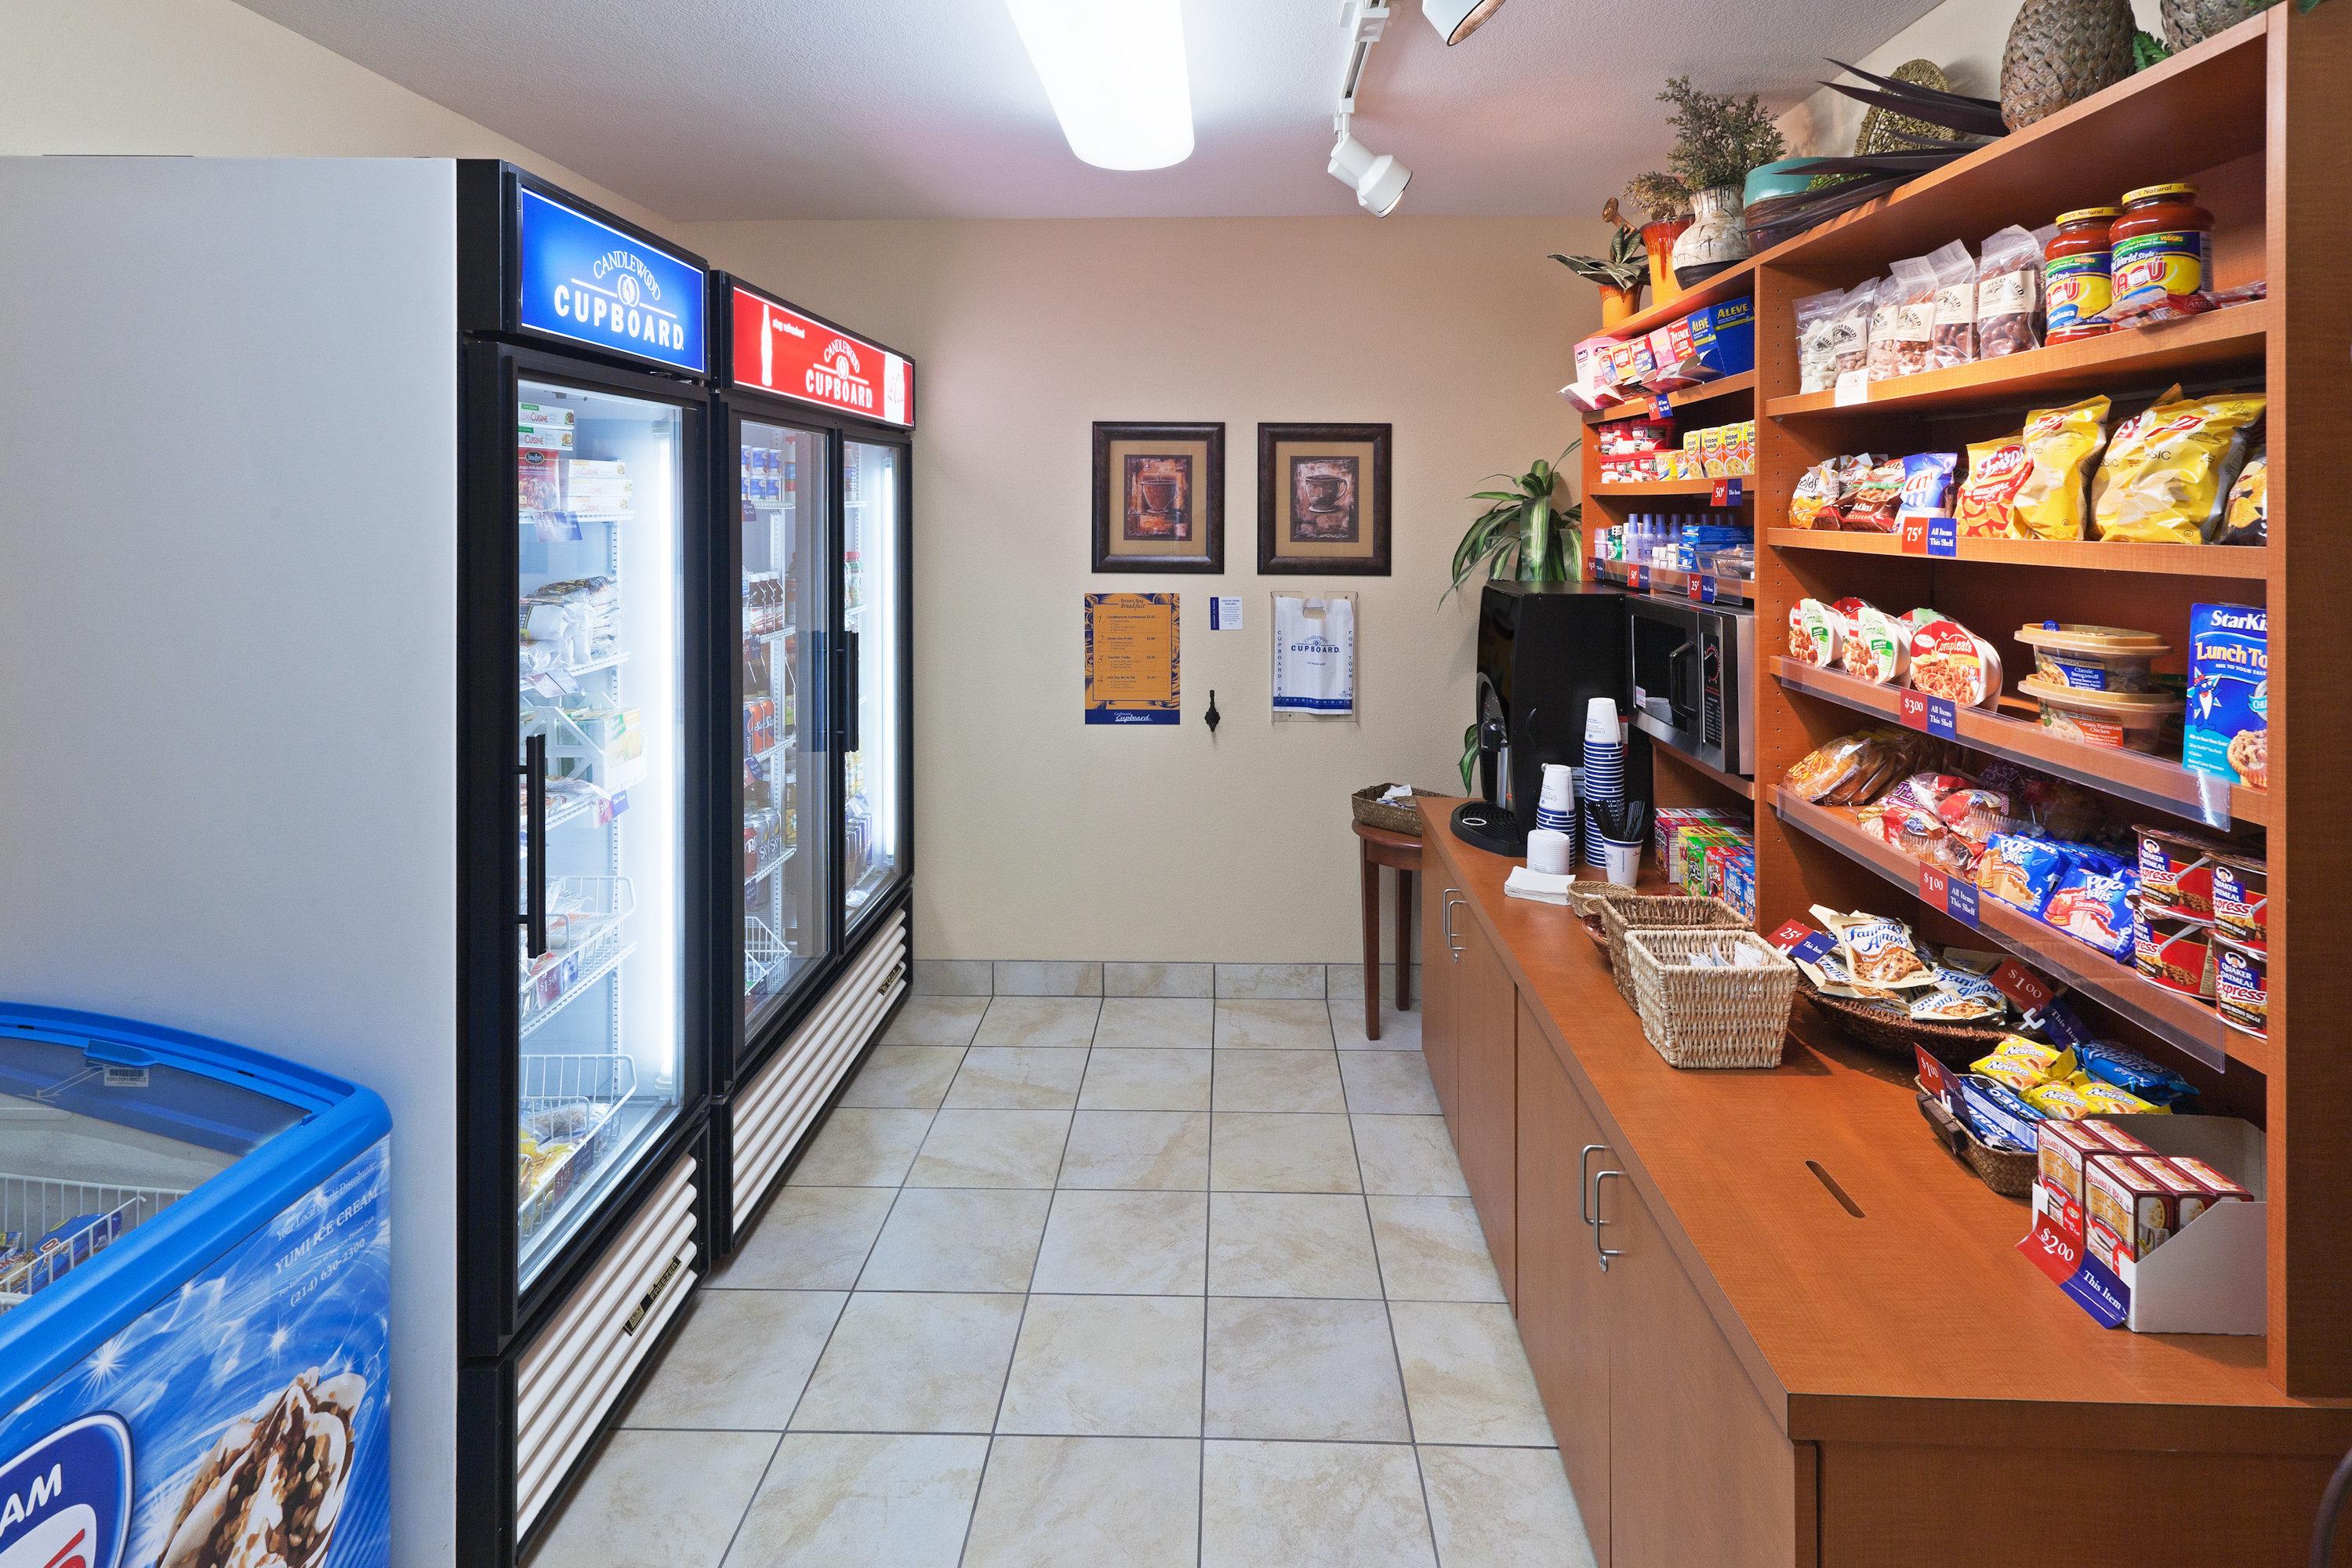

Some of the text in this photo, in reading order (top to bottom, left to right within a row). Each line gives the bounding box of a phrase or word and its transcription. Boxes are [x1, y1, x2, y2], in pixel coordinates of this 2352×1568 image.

[2143, 184, 2172, 194] Natural
[593, 251, 661, 301] CANDLEWOOD
[1716, 303, 1748, 320] ALEVE
[1692, 317, 1710, 333] ALEVE
[824, 339, 860, 373] CANDLEWOOD
[1852, 503, 1875, 512] Mini
[1906, 525, 1923, 542] 75¢
[1939, 528, 1953, 537] Items
[1929, 537, 1954, 547] This Shelf
[1120, 603, 1145, 612] Breakfast
[2211, 609, 2267, 632] StarKi
[1934, 636, 1973, 655] Compleats
[2195, 641, 2247, 666] Lunch
[1930, 705, 1951, 718] All Items
[1929, 714, 1953, 729] This Shelf
[2141, 849, 2164, 863] QUAKER
[1923, 872, 1944, 891] $100
[2214, 878, 2238, 892] QUAKER
[1951, 887, 1974, 905] All Items
[2035, 887, 2043, 898] 2
[1950, 896, 1976, 916] This Shelf
[2072, 901, 2110, 915] Strawberry
[1780, 927, 1803, 940] 25¢
[1845, 924, 1904, 942] Famous
[1861, 932, 1904, 952] Amos
[1803, 940, 1814, 949] This
[2220, 971, 2256, 989] OATMEAL
[2221, 962, 2252, 980] QUAKER
[2007, 968, 2042, 999] $100
[2216, 975, 2267, 1001] Express
[2051, 1008, 2066, 1028] This
[2004, 1046, 2045, 1058] Newtons
[1921, 1056, 1939, 1078] $100
[1985, 1060, 2030, 1076] Newtons
[2041, 1089, 2087, 1107] Newtons
[2087, 1087, 2137, 1105] Newtons
[2038, 1134, 2063, 1155] BUMBLE
[2063, 1148, 2074, 1166] BEE
[2086, 1171, 2125, 1207] BUMBLE BEE
[274, 1185, 379, 1276] YUMI ICE CREAM
[277, 1225, 294, 1242] Your
[2040, 1228, 2074, 1261] $200
[290, 1238, 365, 1307] (214) 630-2300
[649, 1261, 678, 1300] FREEZER
[2083, 1269, 2122, 1310] This Item
